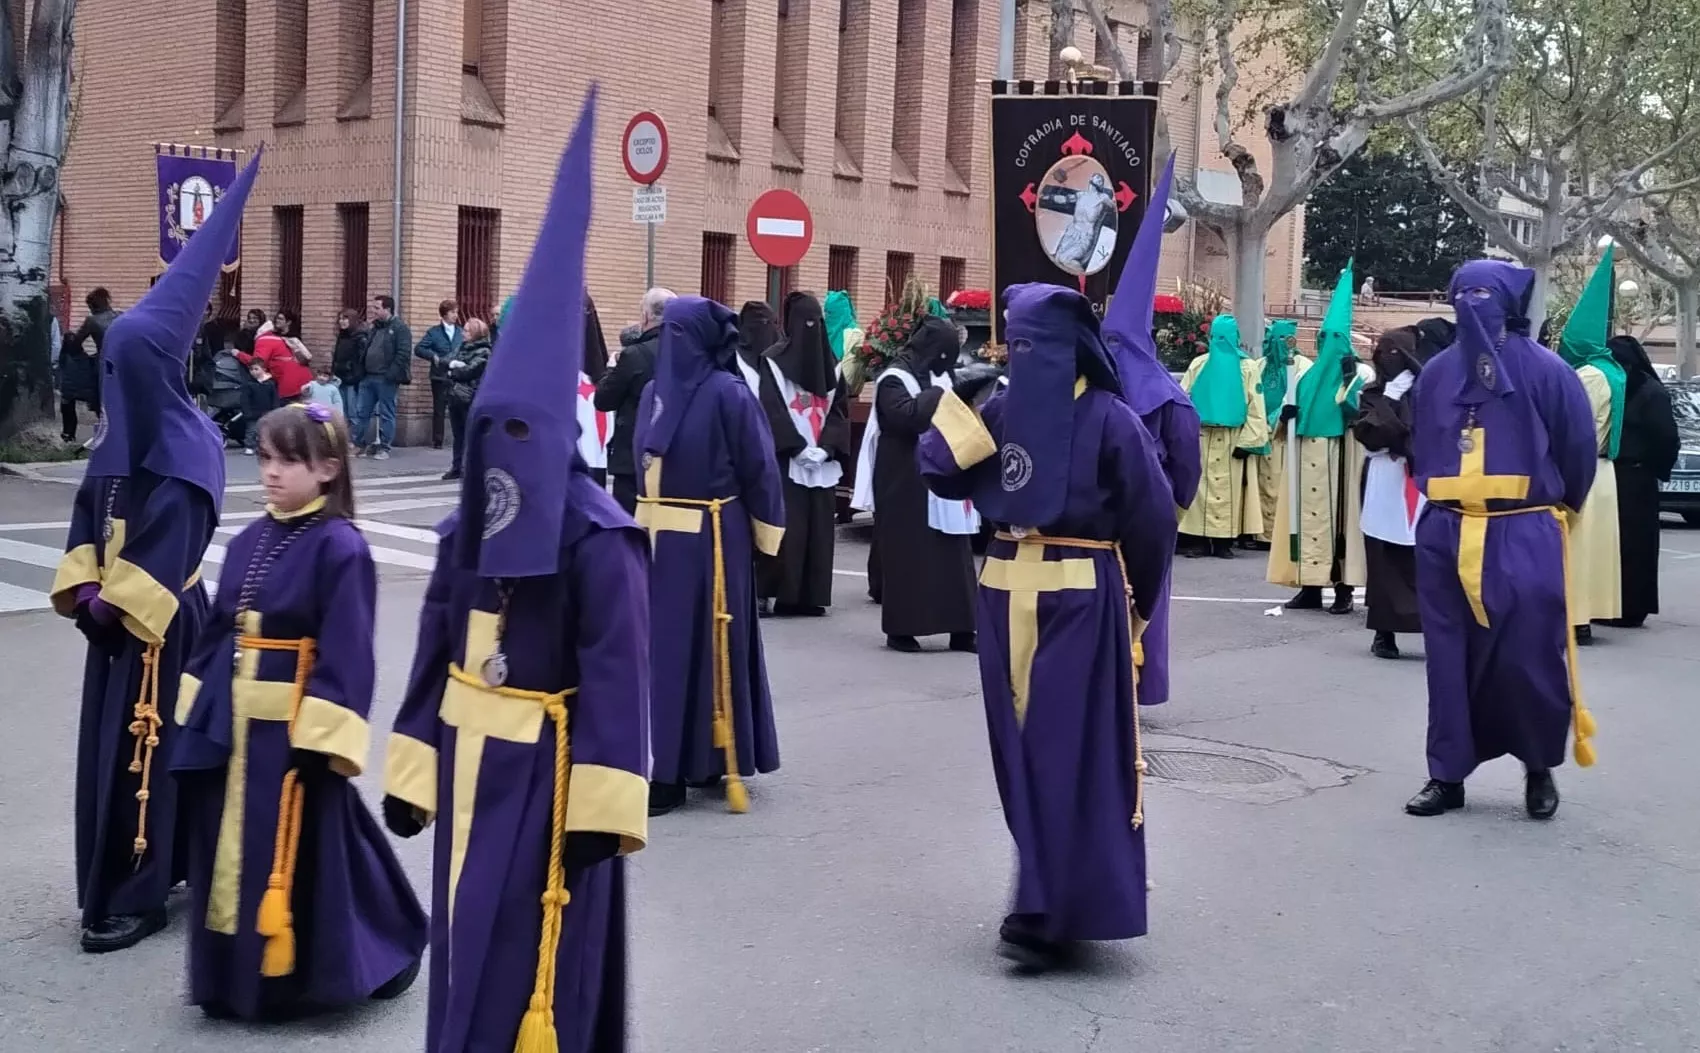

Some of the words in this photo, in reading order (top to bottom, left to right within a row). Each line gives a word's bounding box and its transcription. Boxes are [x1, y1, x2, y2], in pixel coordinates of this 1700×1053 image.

[633, 137, 656, 147] EXCEPTO
[1015, 119, 1063, 167] COFRADIA
[1070, 114, 1086, 126] DE
[1092, 115, 1140, 167] SANTIAGO
